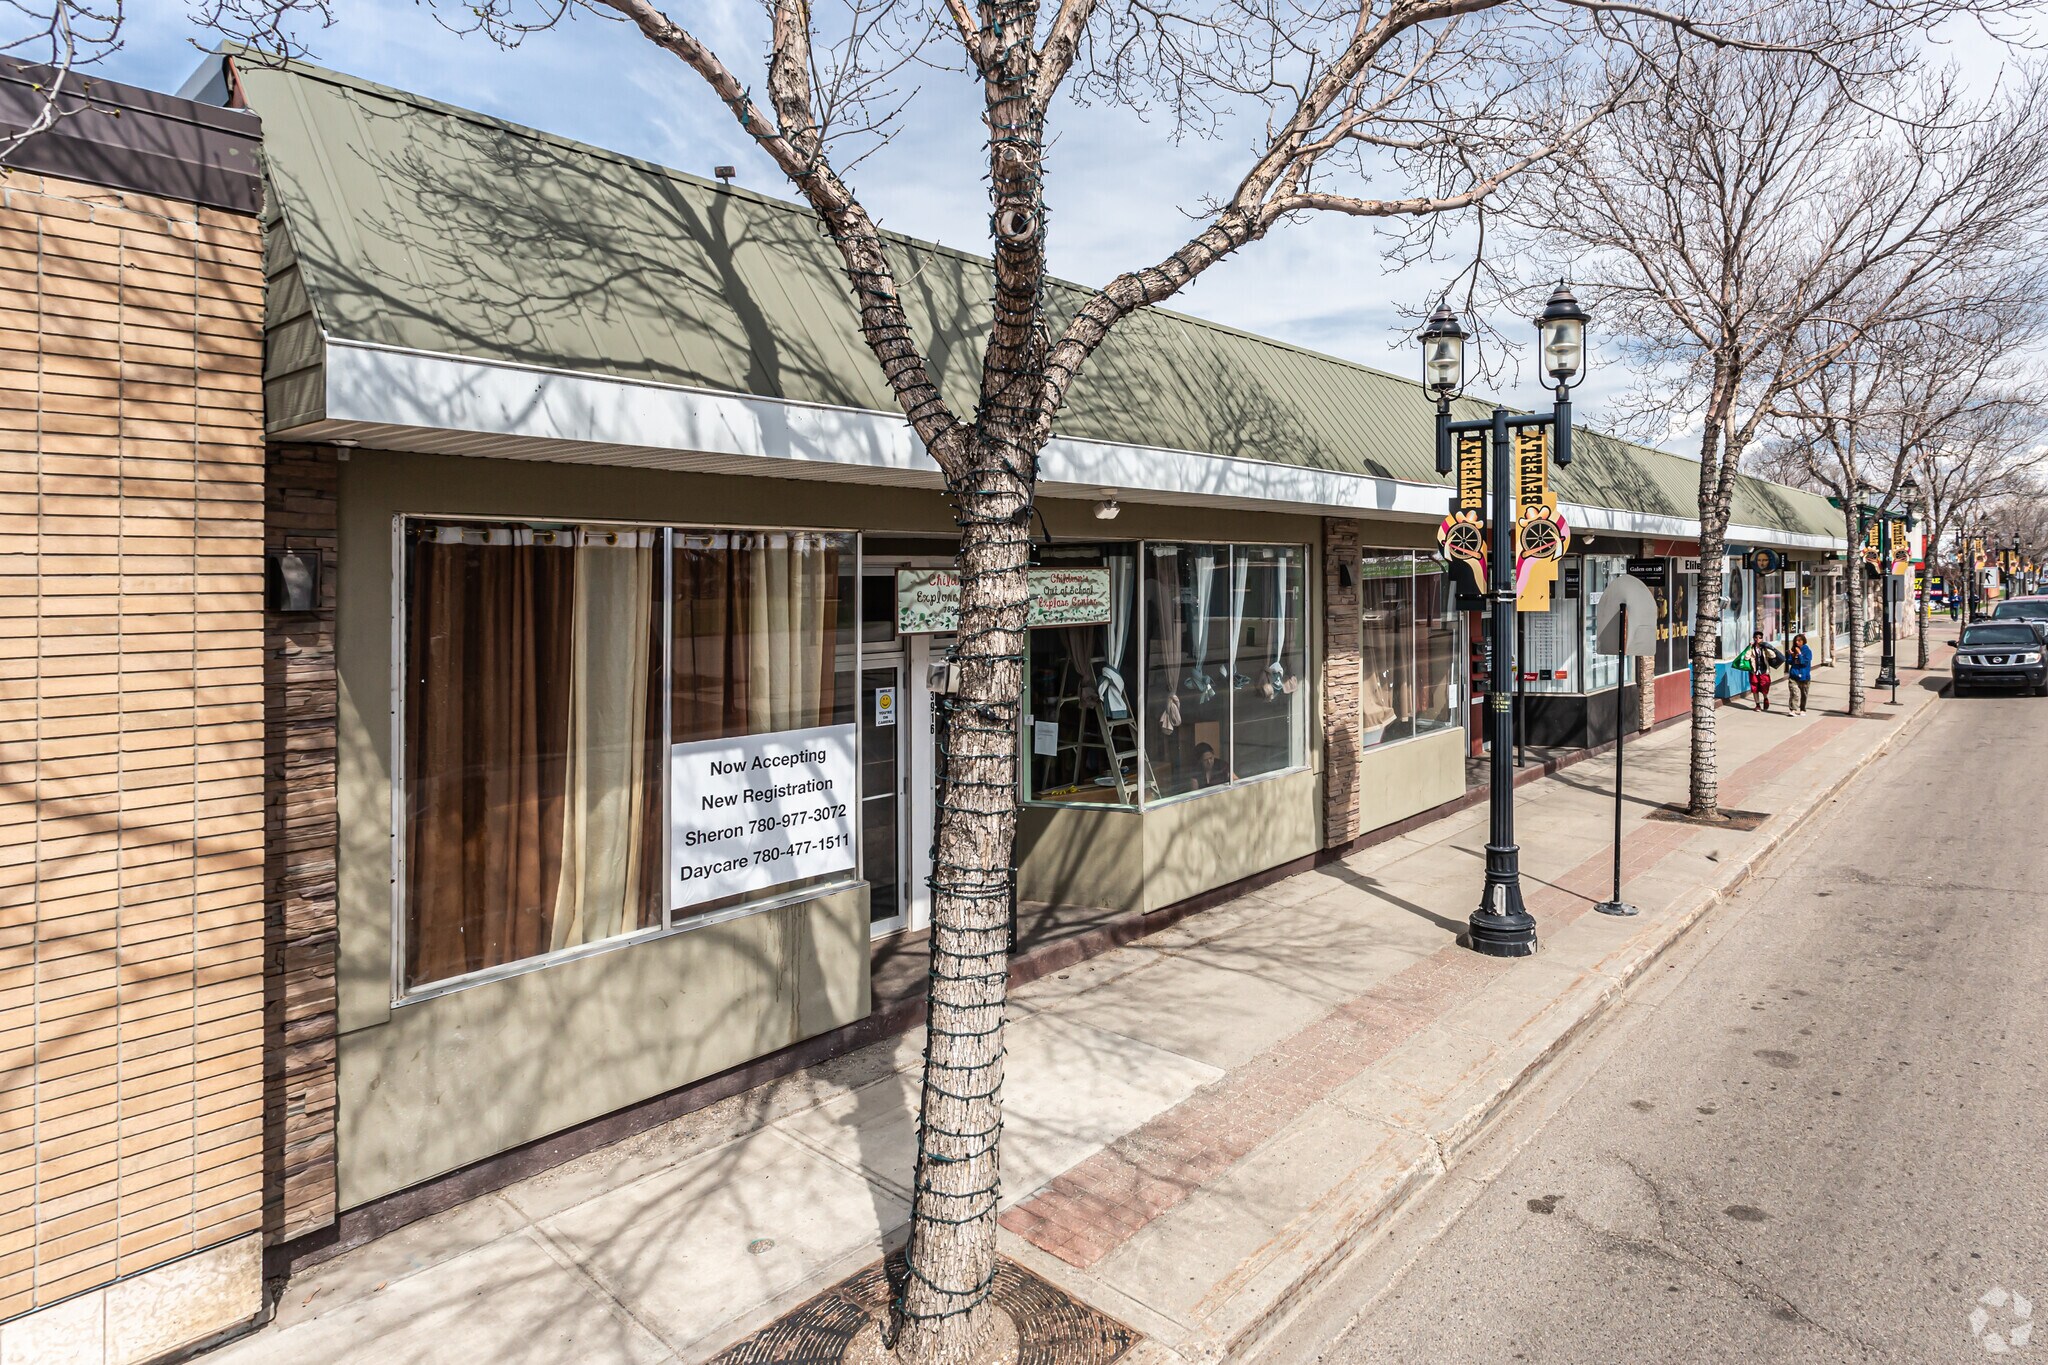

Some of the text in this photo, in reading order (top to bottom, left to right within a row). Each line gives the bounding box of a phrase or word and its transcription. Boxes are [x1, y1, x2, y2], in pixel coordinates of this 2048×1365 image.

[1460, 439, 1482, 509] BEVERLY
[1521, 434, 1542, 505] BEVERLY
[1038, 597, 1069, 610] Explore
[1043, 585, 1059, 596] Out
[1069, 584, 1094, 596] School
[710, 749, 826, 776] Now Accepting
[702, 778, 833, 810] New Registration
[685, 804, 847, 846] Sheron 780-977-3072
[680, 833, 849, 881] Daycare 780-477-1511
